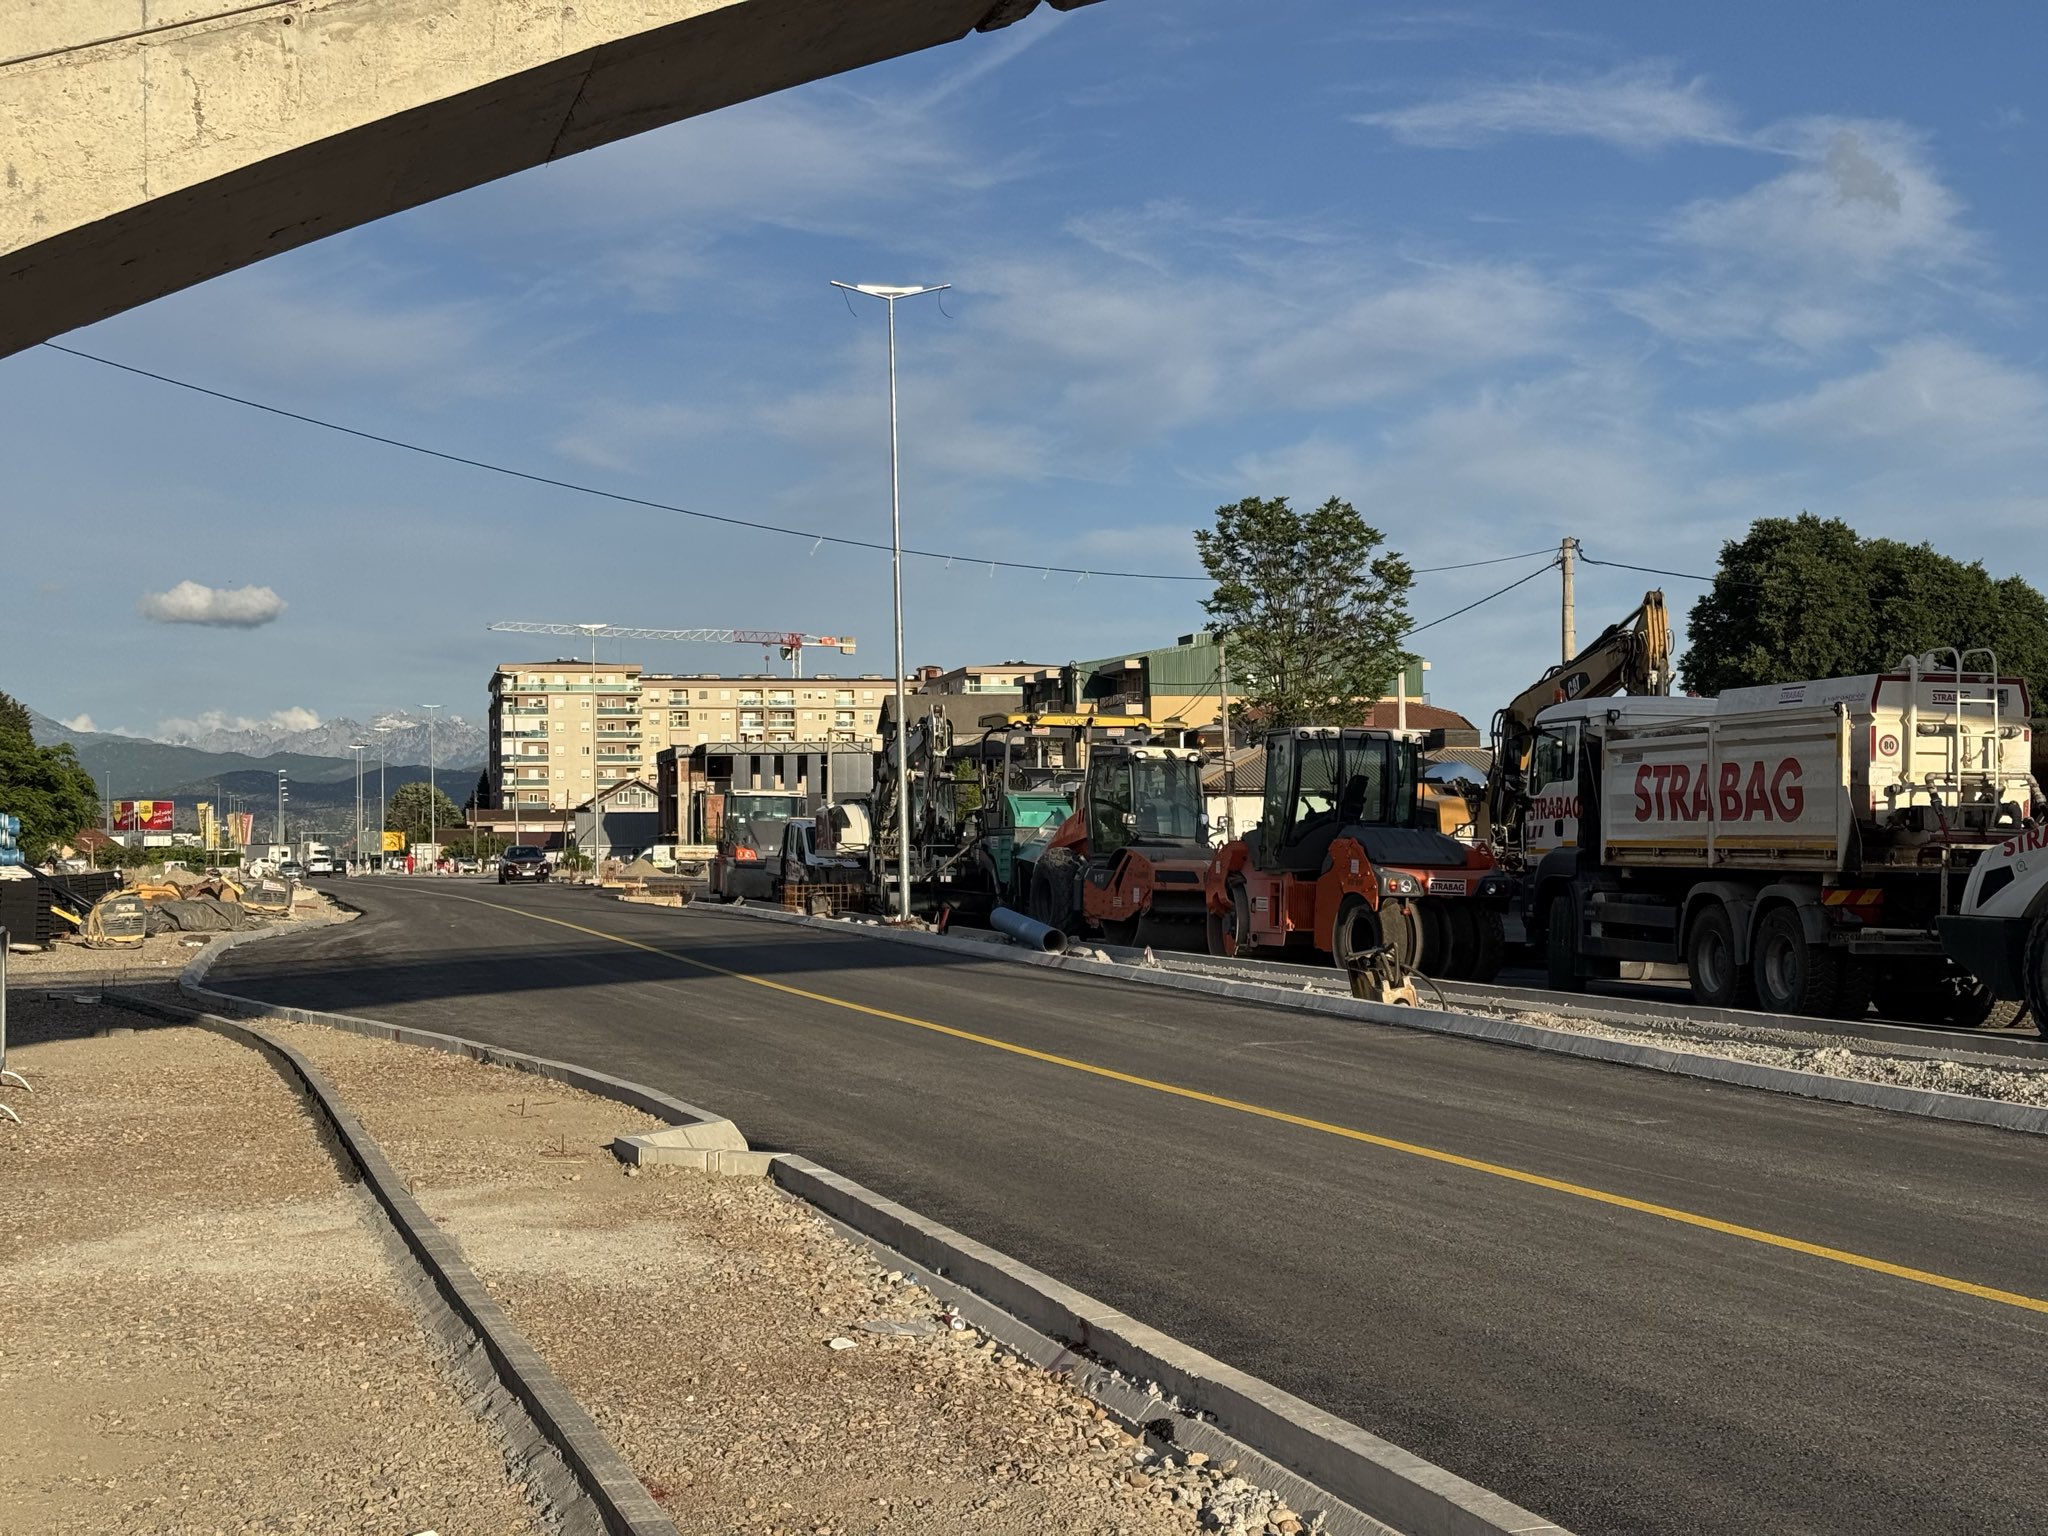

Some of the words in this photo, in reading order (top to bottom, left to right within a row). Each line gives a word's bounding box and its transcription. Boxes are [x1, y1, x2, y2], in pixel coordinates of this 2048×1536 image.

[1567, 674, 1580, 698] CAT
[1780, 690, 1805, 699] STRABAG
[1884, 740, 1895, 750] 80
[1634, 757, 1804, 823] STRABAG
[1430, 882, 1465, 892] STRABAG
